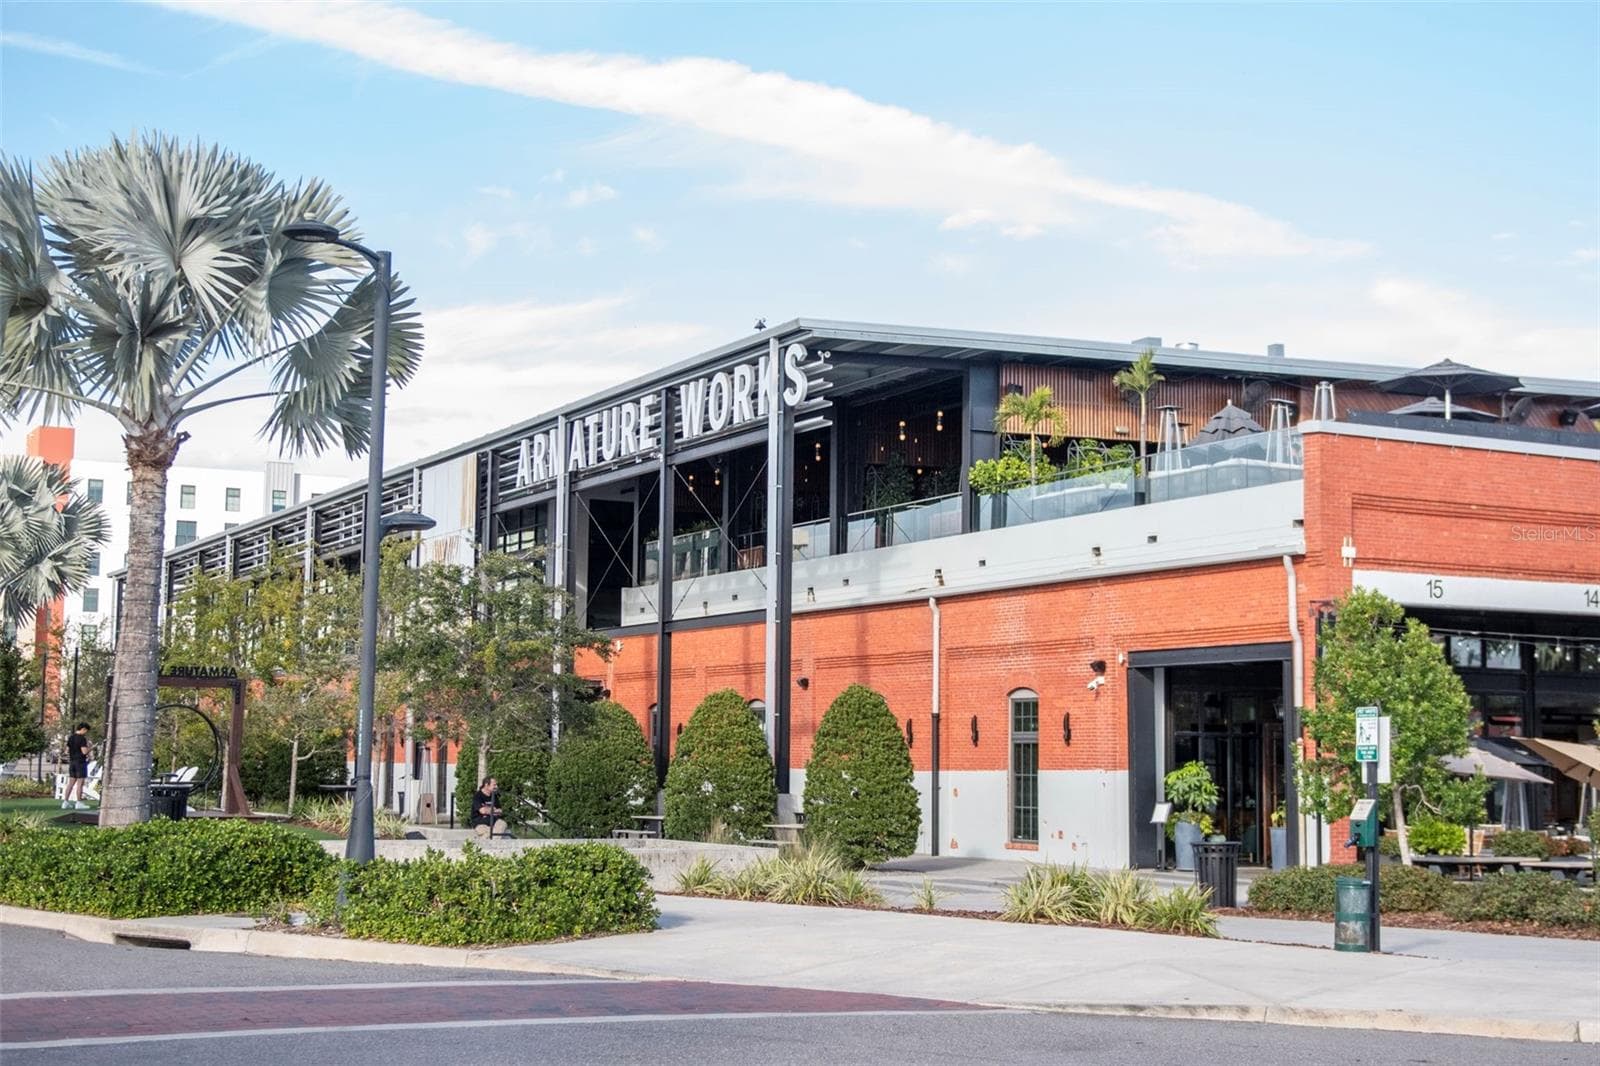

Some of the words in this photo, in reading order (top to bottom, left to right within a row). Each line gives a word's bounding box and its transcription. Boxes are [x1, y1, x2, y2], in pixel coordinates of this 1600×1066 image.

[680, 343, 808, 439] WORKS
[1426, 579, 1443, 599] 15
[1584, 589, 1600, 608] 14
